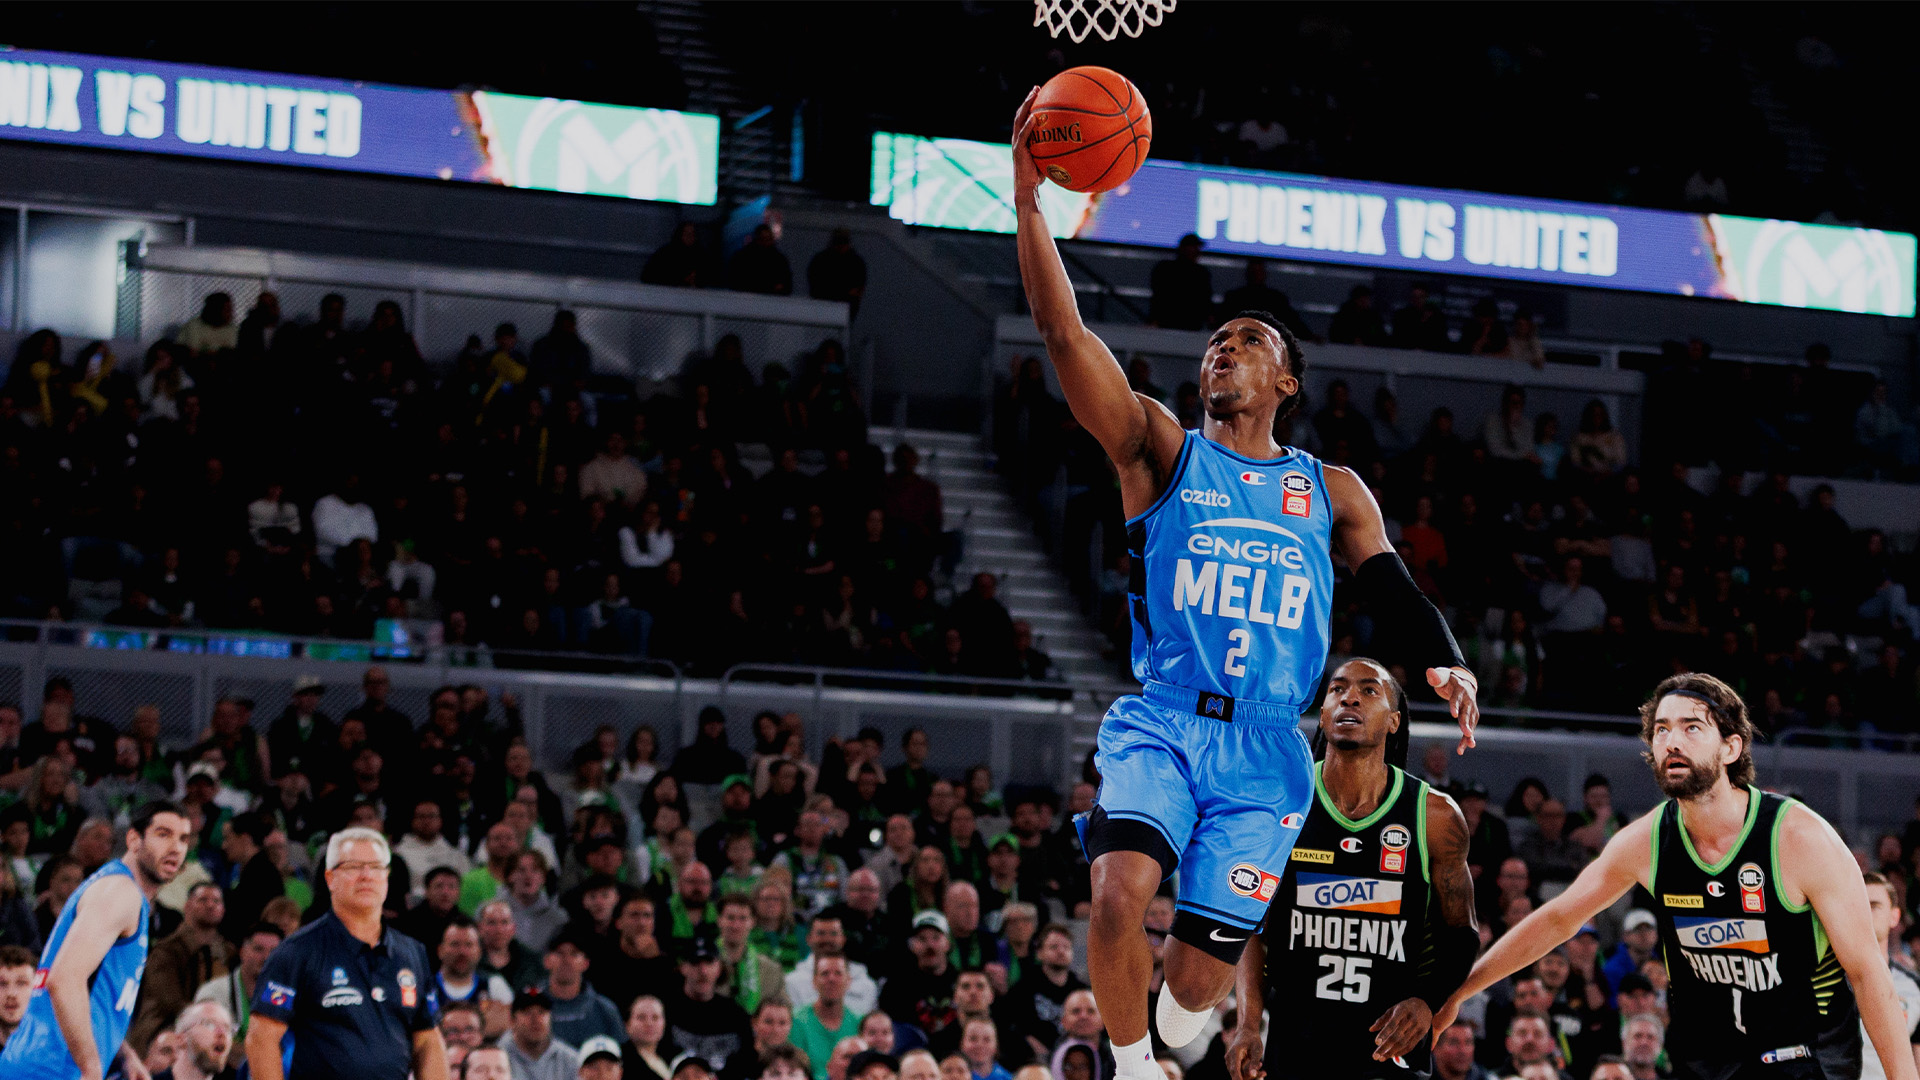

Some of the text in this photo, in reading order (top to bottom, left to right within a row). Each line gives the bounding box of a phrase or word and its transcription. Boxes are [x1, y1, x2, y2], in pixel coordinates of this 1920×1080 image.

[94, 68, 166, 139] VS
[176, 76, 362, 158] UNITED
[1028, 122, 1083, 147] ALDING
[1197, 178, 1619, 277] PHOENIX VS UNITED
[1287, 477, 1306, 490] NBL
[1180, 488, 1231, 507] ozito
[1173, 558, 1311, 630] MELB
[1224, 628, 1250, 678] 2
[1386, 831, 1403, 845] NBL
[1294, 850, 1331, 861] STANLEY
[1234, 870, 1255, 889] NBL
[1743, 871, 1758, 885] NBL
[1314, 881, 1379, 906] GOAT
[1666, 897, 1701, 906] STANLEY
[1289, 909, 1407, 962] PHOENIX
[1694, 920, 1746, 945] GOAT
[1316, 954, 1372, 1003] 25
[1680, 947, 1782, 992] PHOENIX
[1732, 988, 1747, 1035] 1
